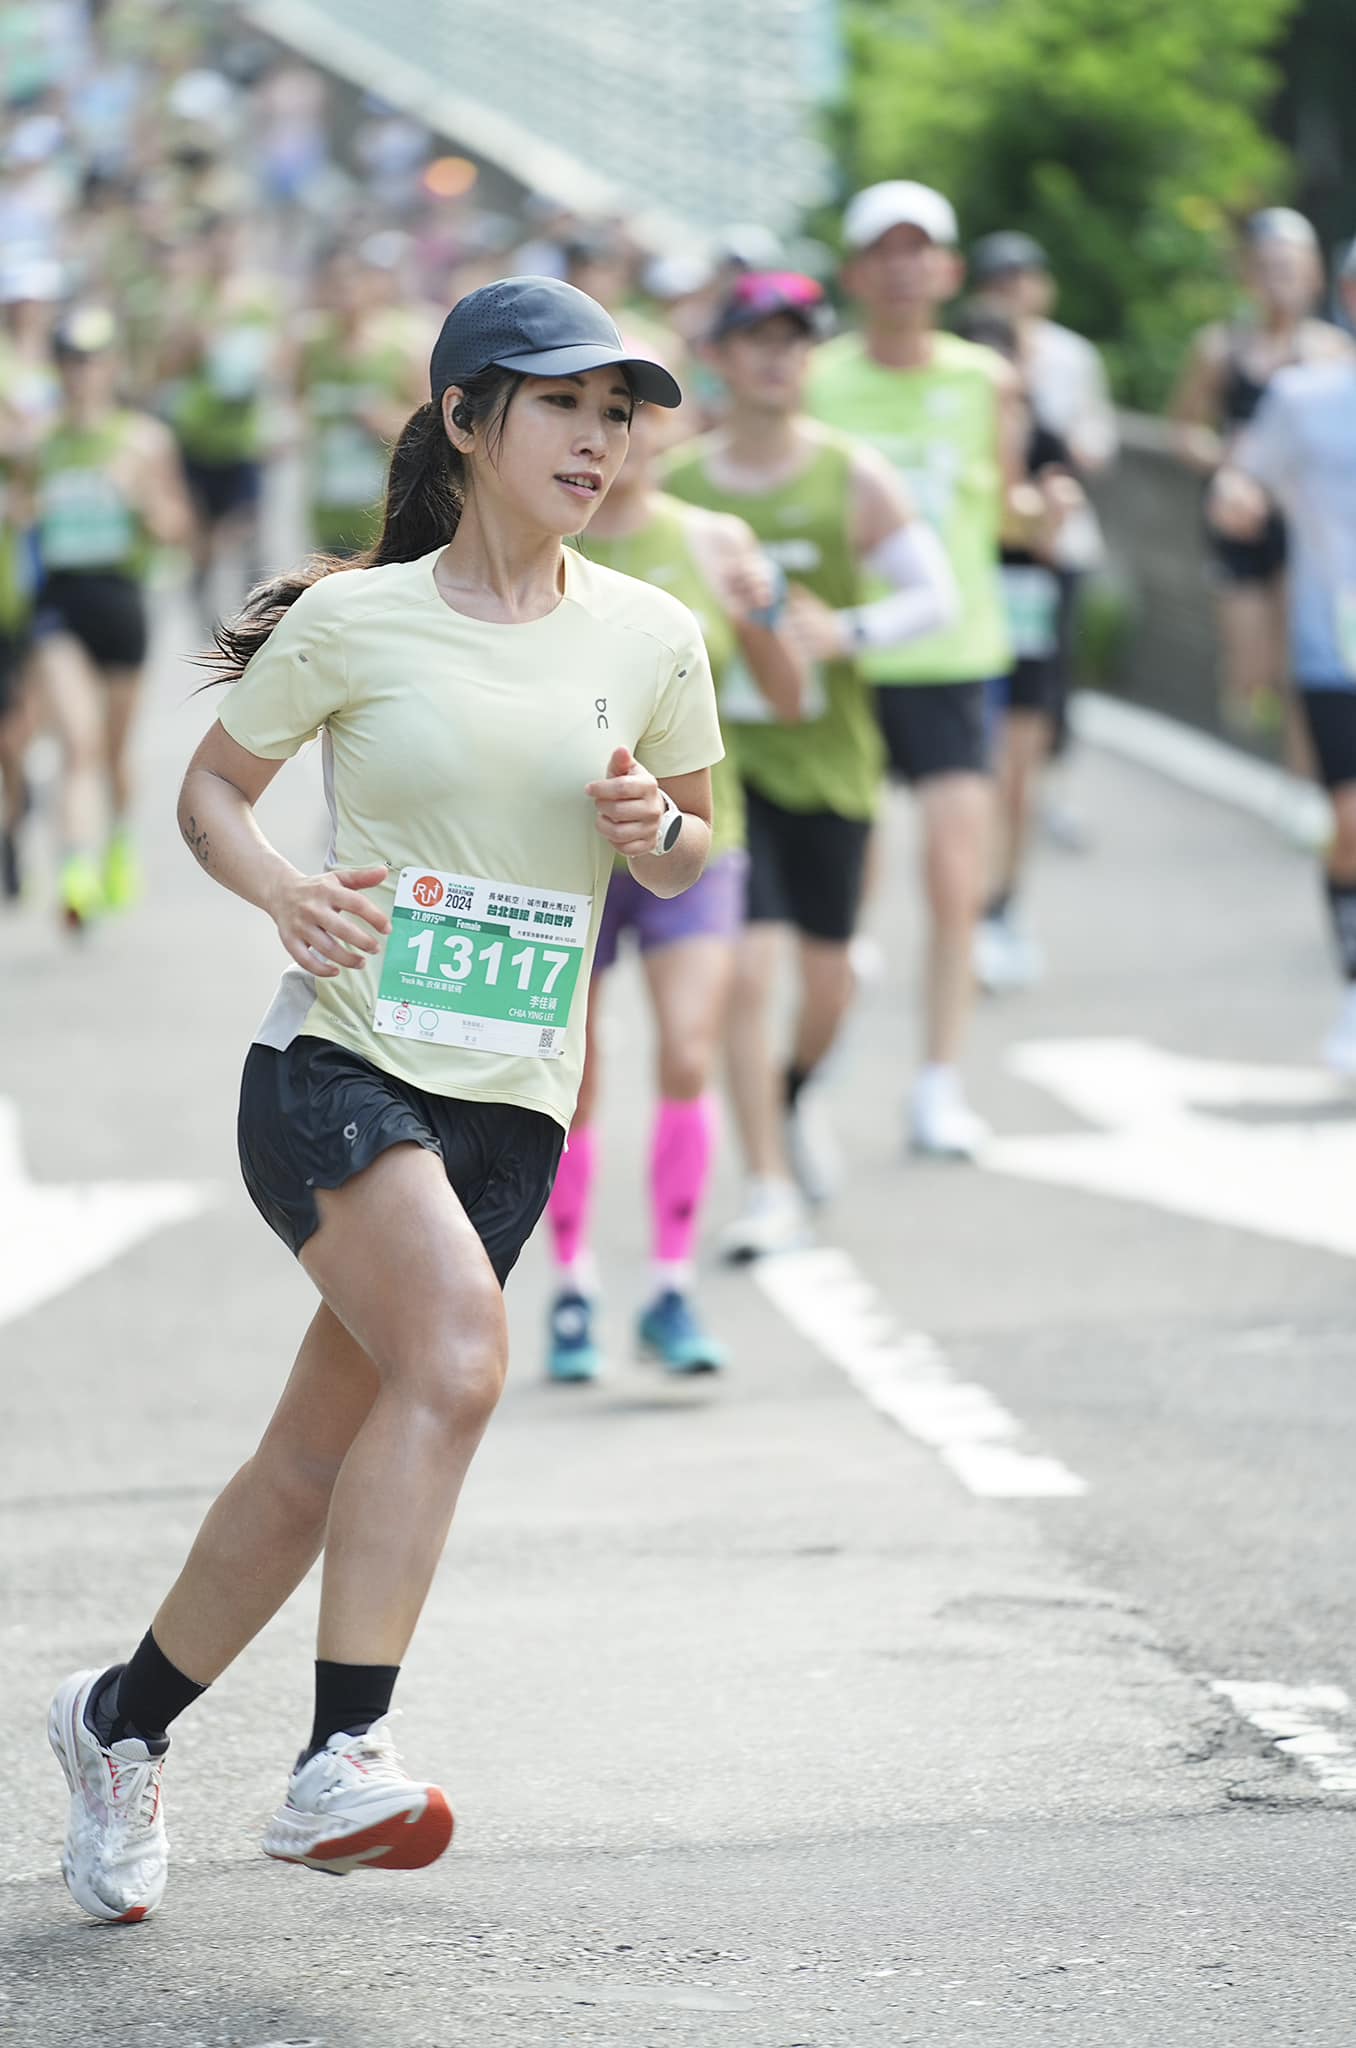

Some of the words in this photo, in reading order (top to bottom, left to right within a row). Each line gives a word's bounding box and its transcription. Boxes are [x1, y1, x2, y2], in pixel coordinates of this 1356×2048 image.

[445, 893, 472, 911] 2024
[456, 918, 481, 932] Female
[407, 928, 570, 994] 13117
[508, 1007, 526, 1018] CHIA
[527, 1010, 544, 1020] YING
[544, 1012, 555, 1022] LEE
